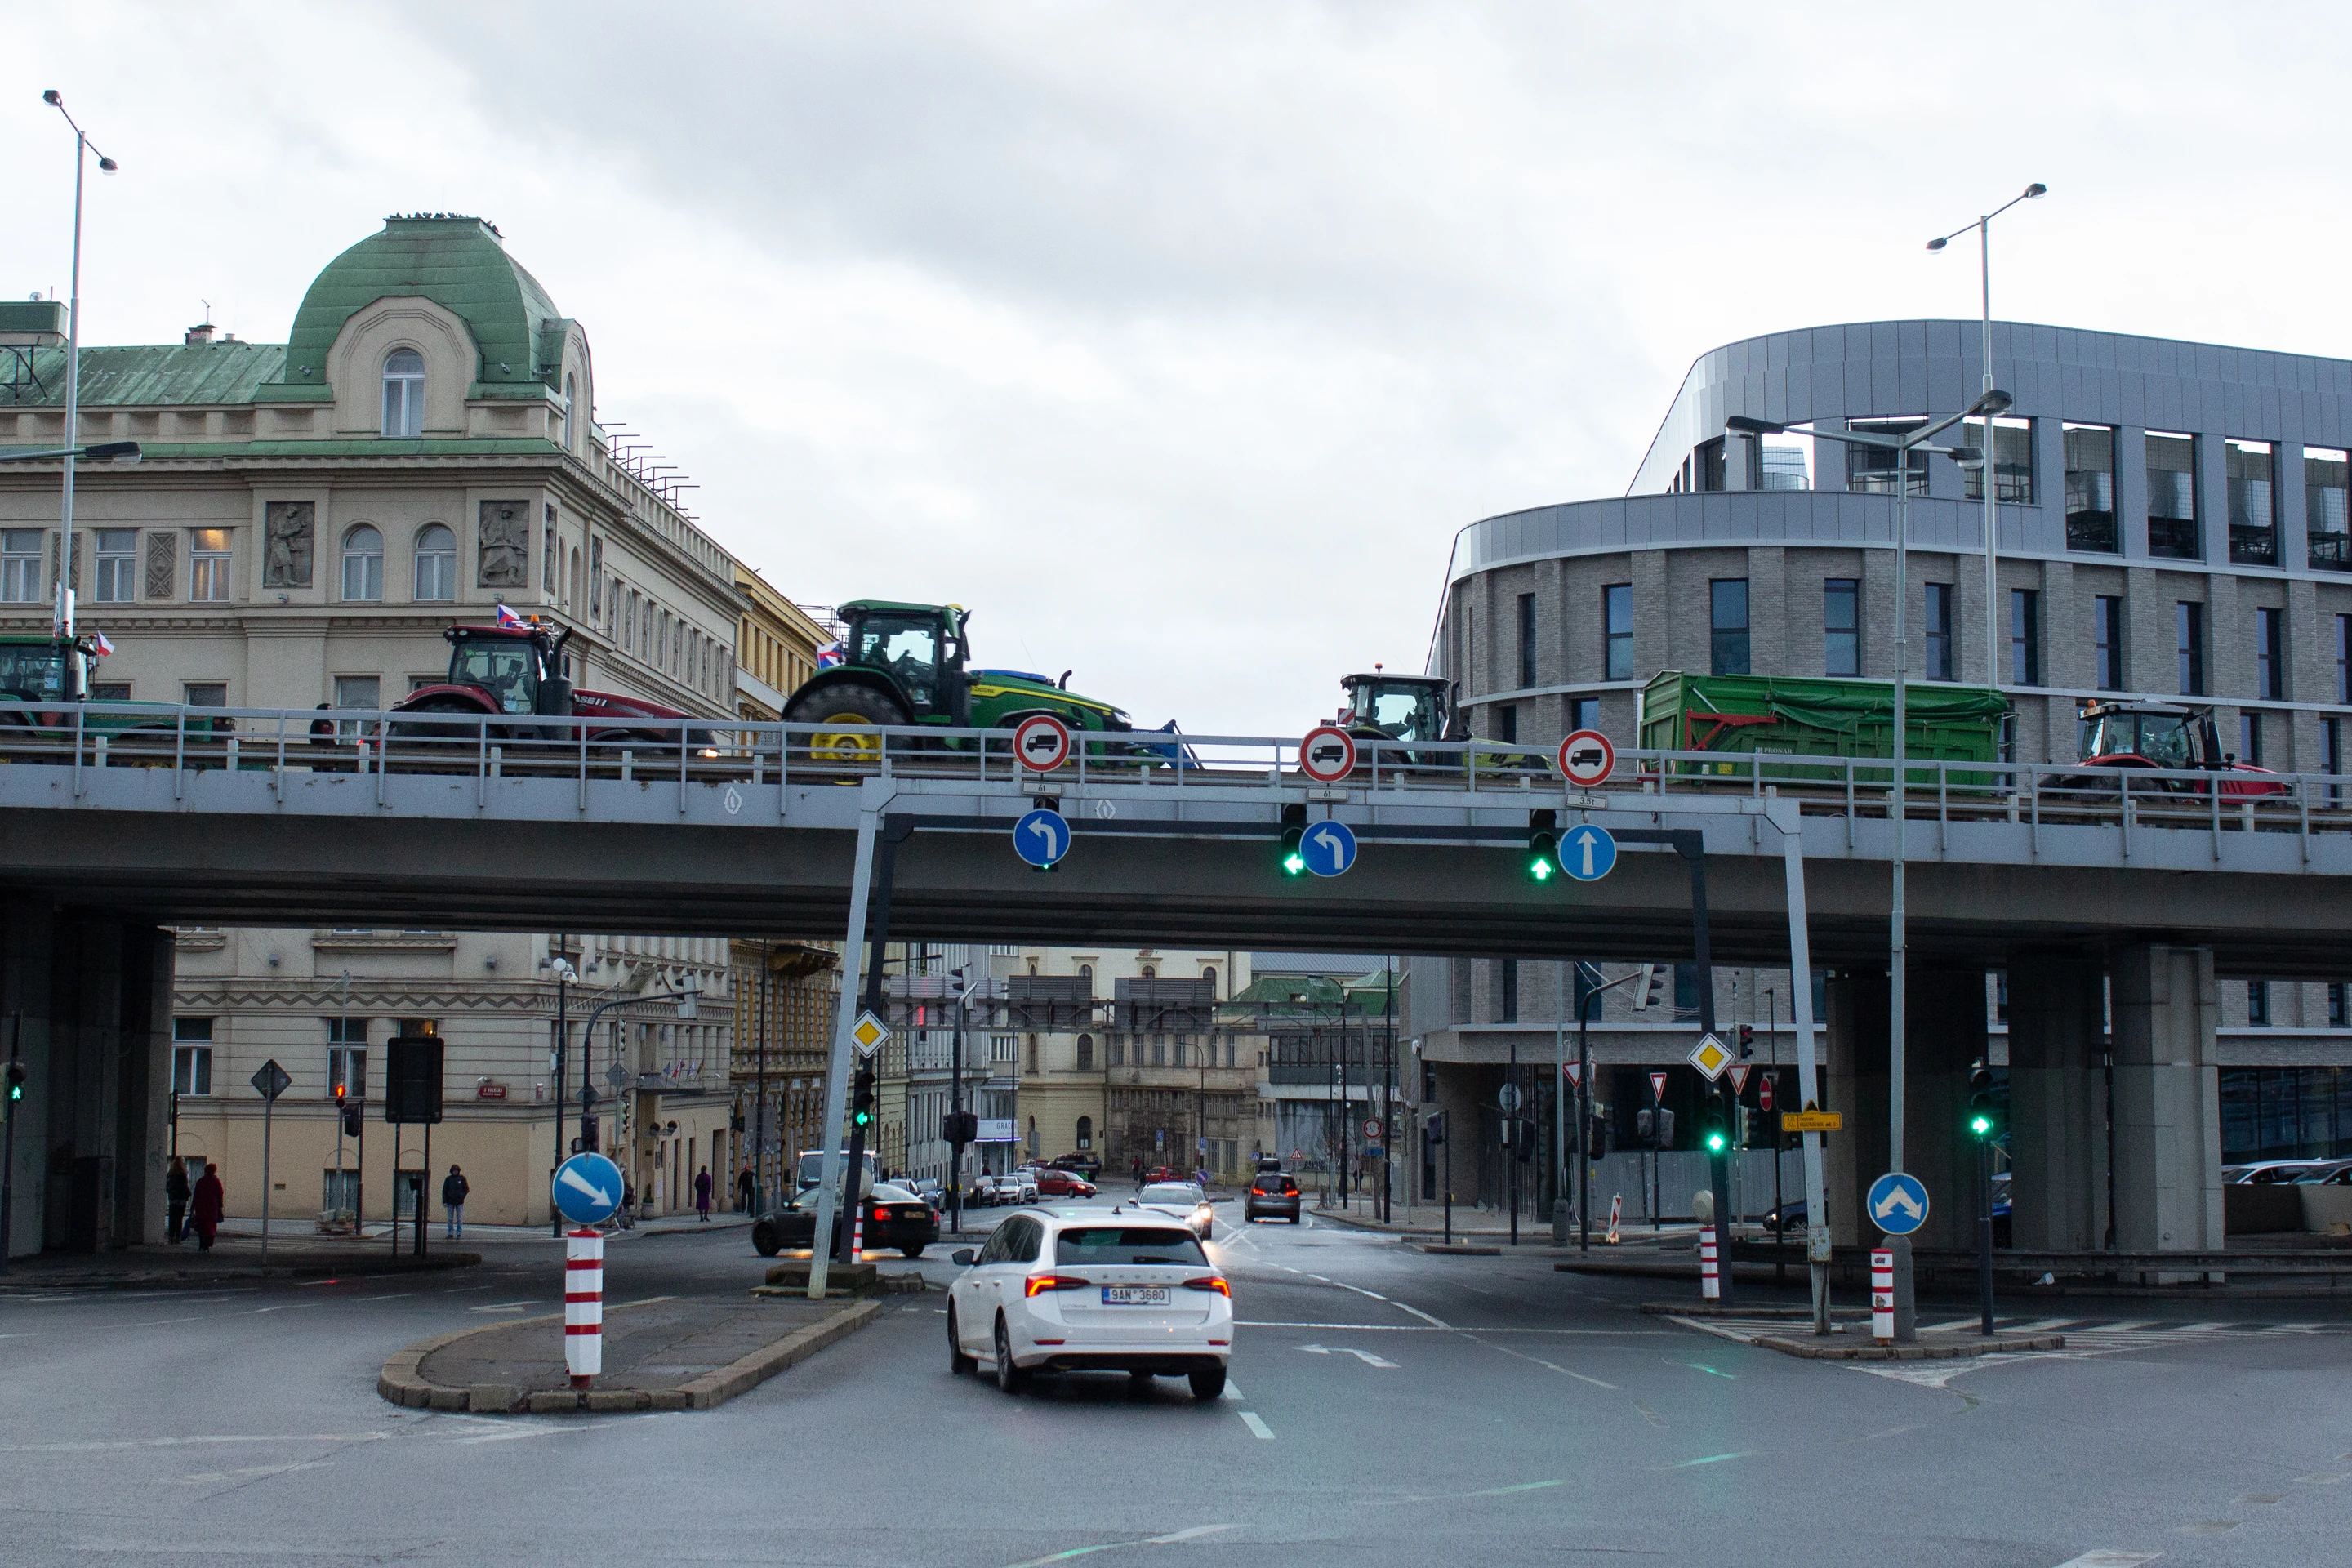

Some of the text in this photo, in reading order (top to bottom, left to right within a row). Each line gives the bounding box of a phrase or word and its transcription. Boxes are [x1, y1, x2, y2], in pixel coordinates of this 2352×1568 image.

[1038, 784, 1045, 792] 6t
[1323, 790, 1331, 798] 6t
[1579, 796, 1595, 806] 3.5t
[1111, 1290, 1165, 1300] 9AN 3680
